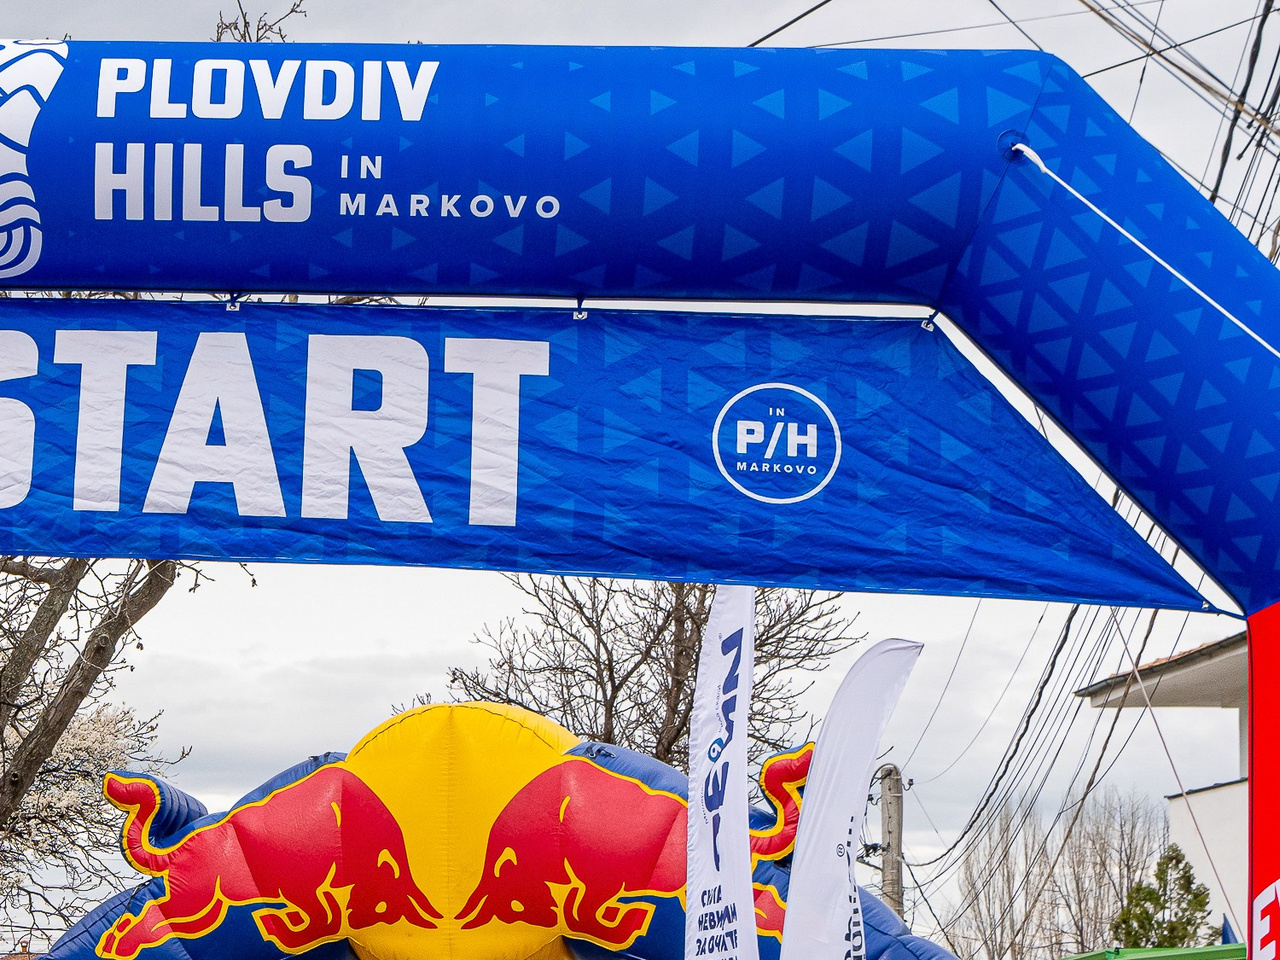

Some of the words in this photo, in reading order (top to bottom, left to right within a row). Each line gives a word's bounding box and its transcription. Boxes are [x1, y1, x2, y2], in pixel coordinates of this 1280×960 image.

[96, 58, 440, 121] PLOVDIV
[340, 155, 383, 180] IN
[94, 142, 312, 223] HILLS
[339, 193, 561, 219] MARKOVO
[768, 407, 786, 417] IN
[736, 420, 818, 459] P/H
[736, 461, 817, 475] MARKOVO
